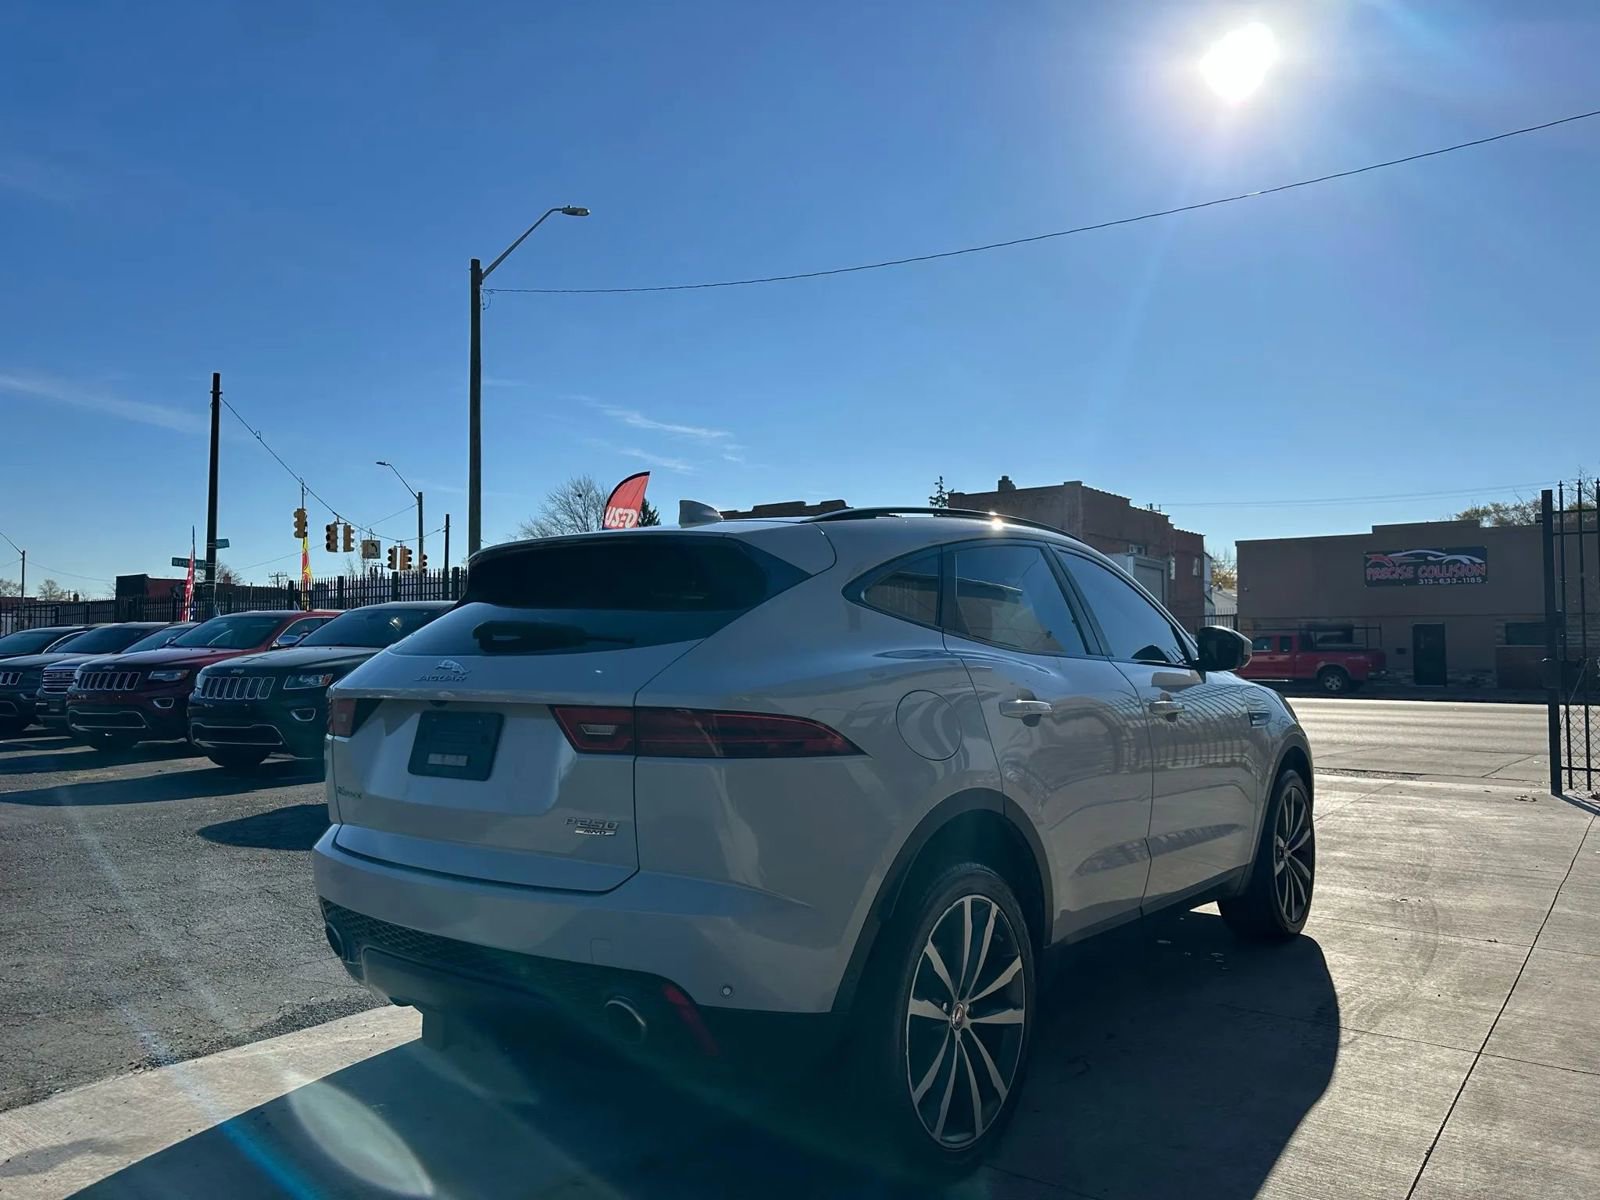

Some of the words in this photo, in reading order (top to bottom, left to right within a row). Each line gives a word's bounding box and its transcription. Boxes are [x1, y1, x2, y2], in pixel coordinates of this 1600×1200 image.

[1366, 565, 1415, 581] PRECISE
[1418, 563, 1486, 578] COLLISION
[413, 673, 468, 682] JAGUAR
[563, 816, 619, 830] P250
